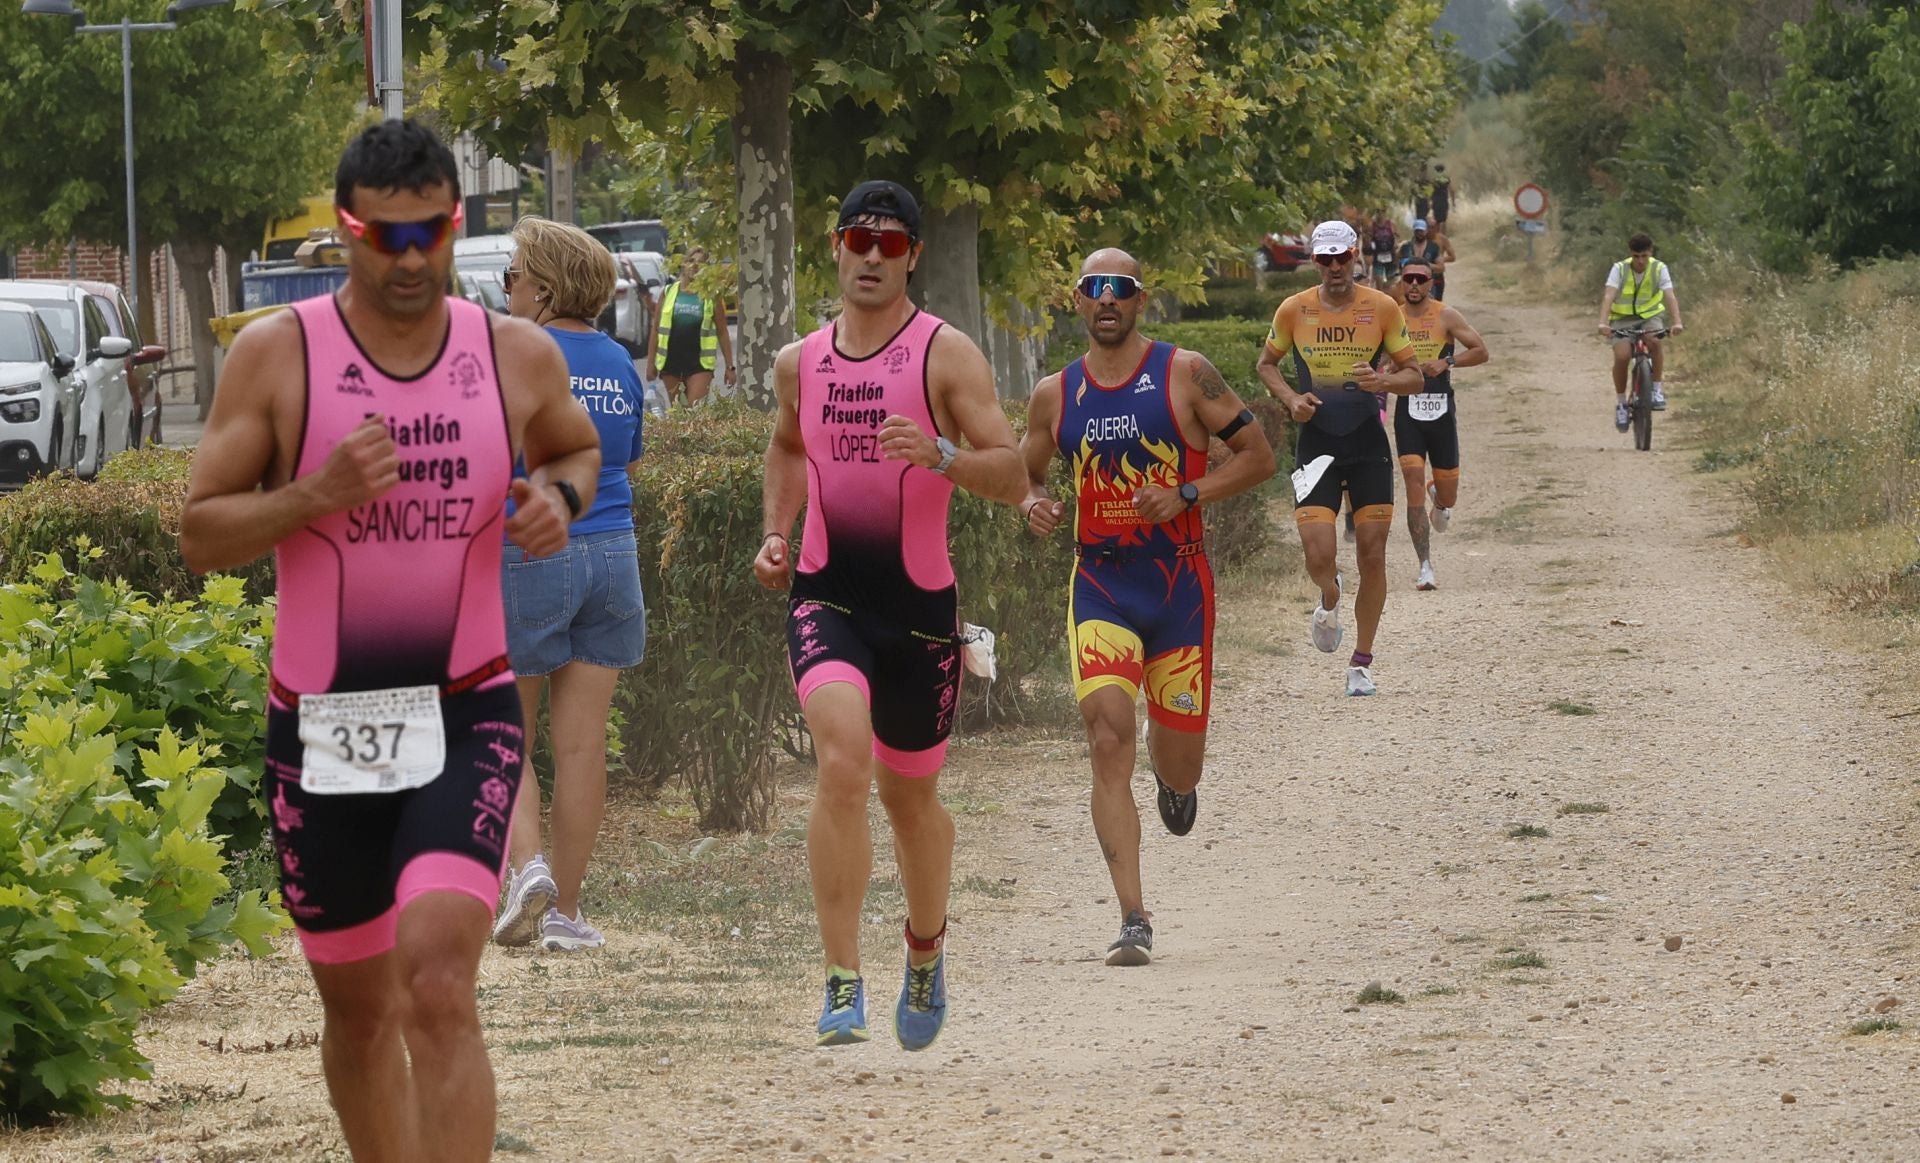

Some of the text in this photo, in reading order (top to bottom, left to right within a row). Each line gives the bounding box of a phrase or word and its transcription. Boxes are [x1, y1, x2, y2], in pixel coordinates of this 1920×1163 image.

[1316, 327, 1356, 343] INDY
[569, 375, 624, 394] FICIAL
[827, 381, 884, 403] Triatlón
[578, 393, 634, 416] ATLÓN
[1415, 401, 1441, 411] 1300
[364, 411, 461, 446] iatlón
[822, 404, 887, 430] Pisuerga
[1085, 413, 1140, 442] GUERRA
[831, 428, 880, 463] LÓPEZ
[398, 457, 468, 490] uerga
[1100, 500, 1134, 509] TRIAT
[1102, 509, 1141, 518] BOMBE
[331, 722, 406, 764] 337
